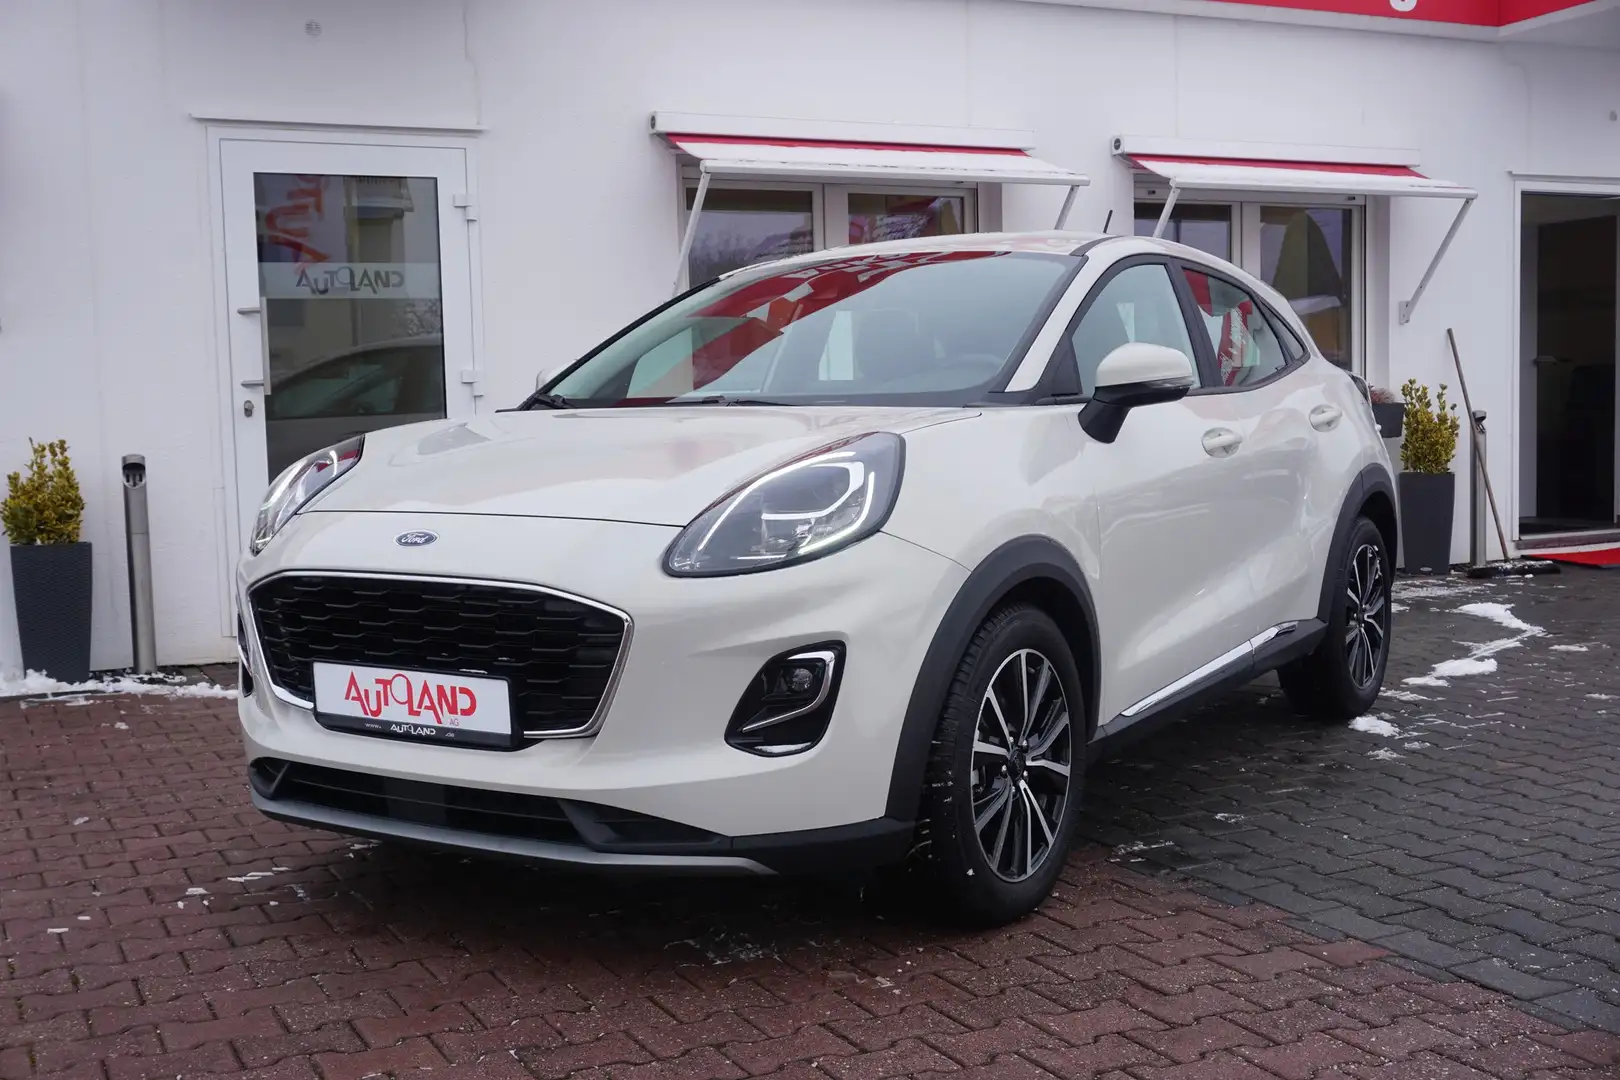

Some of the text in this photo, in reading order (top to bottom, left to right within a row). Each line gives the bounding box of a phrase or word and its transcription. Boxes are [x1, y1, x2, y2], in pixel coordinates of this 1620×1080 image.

[295, 265, 405, 295] AUTOLAND
[401, 532, 429, 544] Ford
[344, 671, 477, 724] AUTOLAND
[449, 718, 459, 727] AG
[390, 723, 436, 736] AUTOLAND
